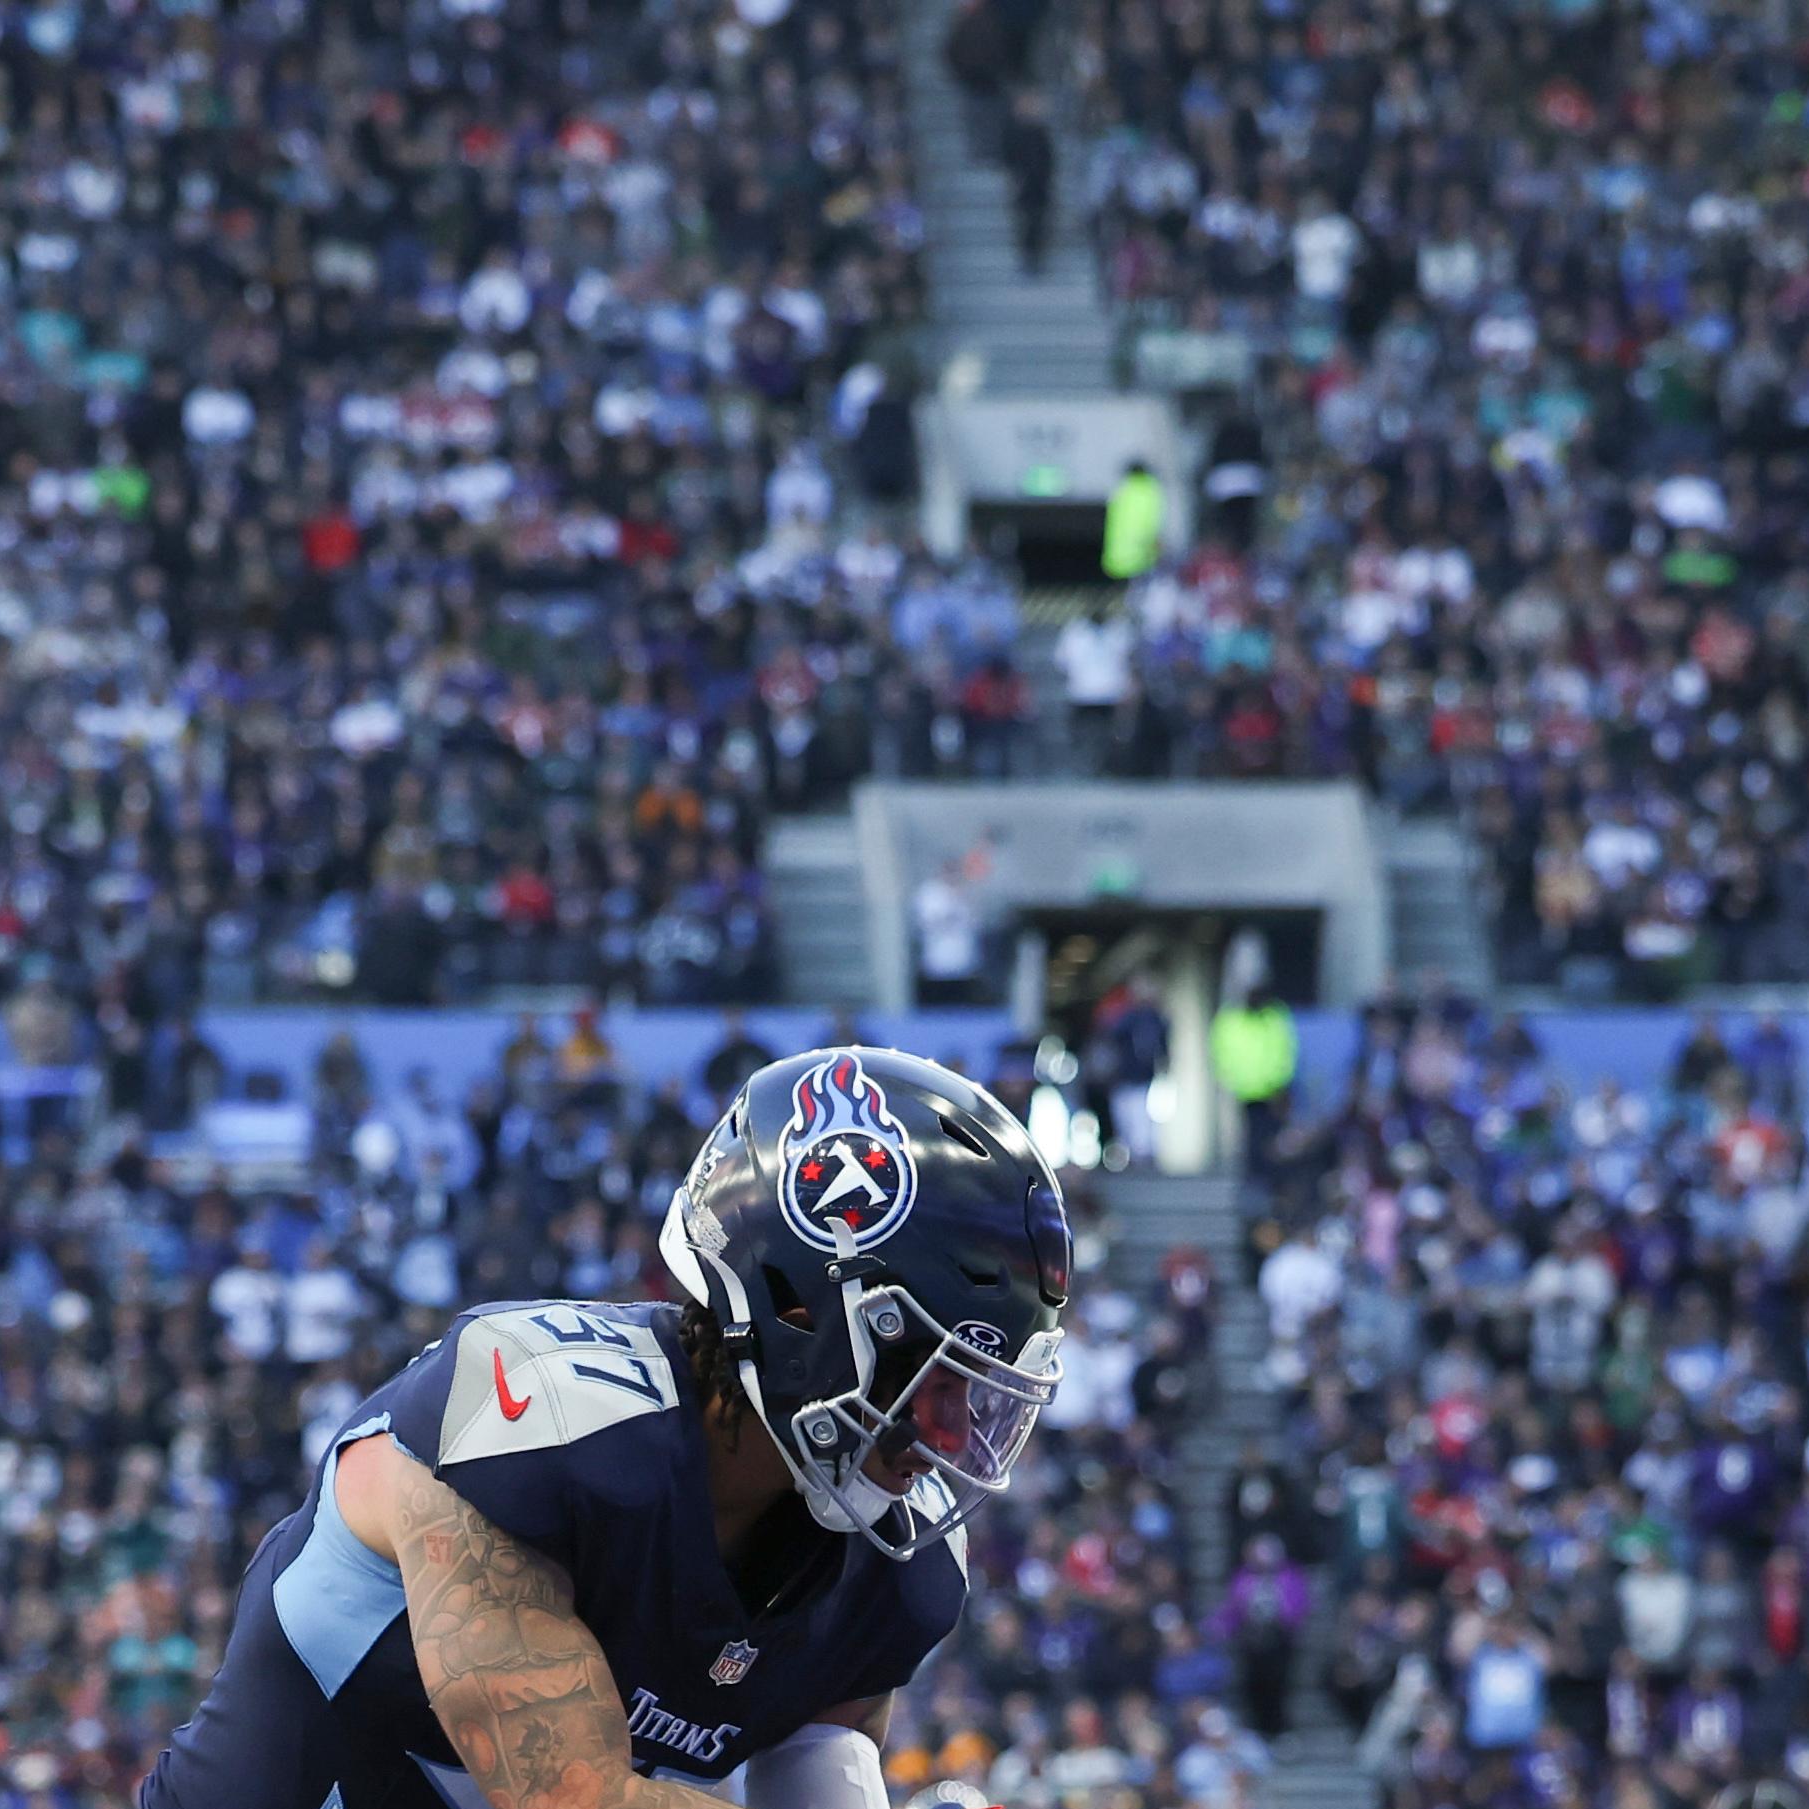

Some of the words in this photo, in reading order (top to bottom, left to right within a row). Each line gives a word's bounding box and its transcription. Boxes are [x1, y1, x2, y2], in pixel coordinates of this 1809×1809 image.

[954, 1330, 1004, 1358] OAKLEY
[716, 1657, 745, 1680] NFL
[628, 1686, 742, 1763] TITANS
